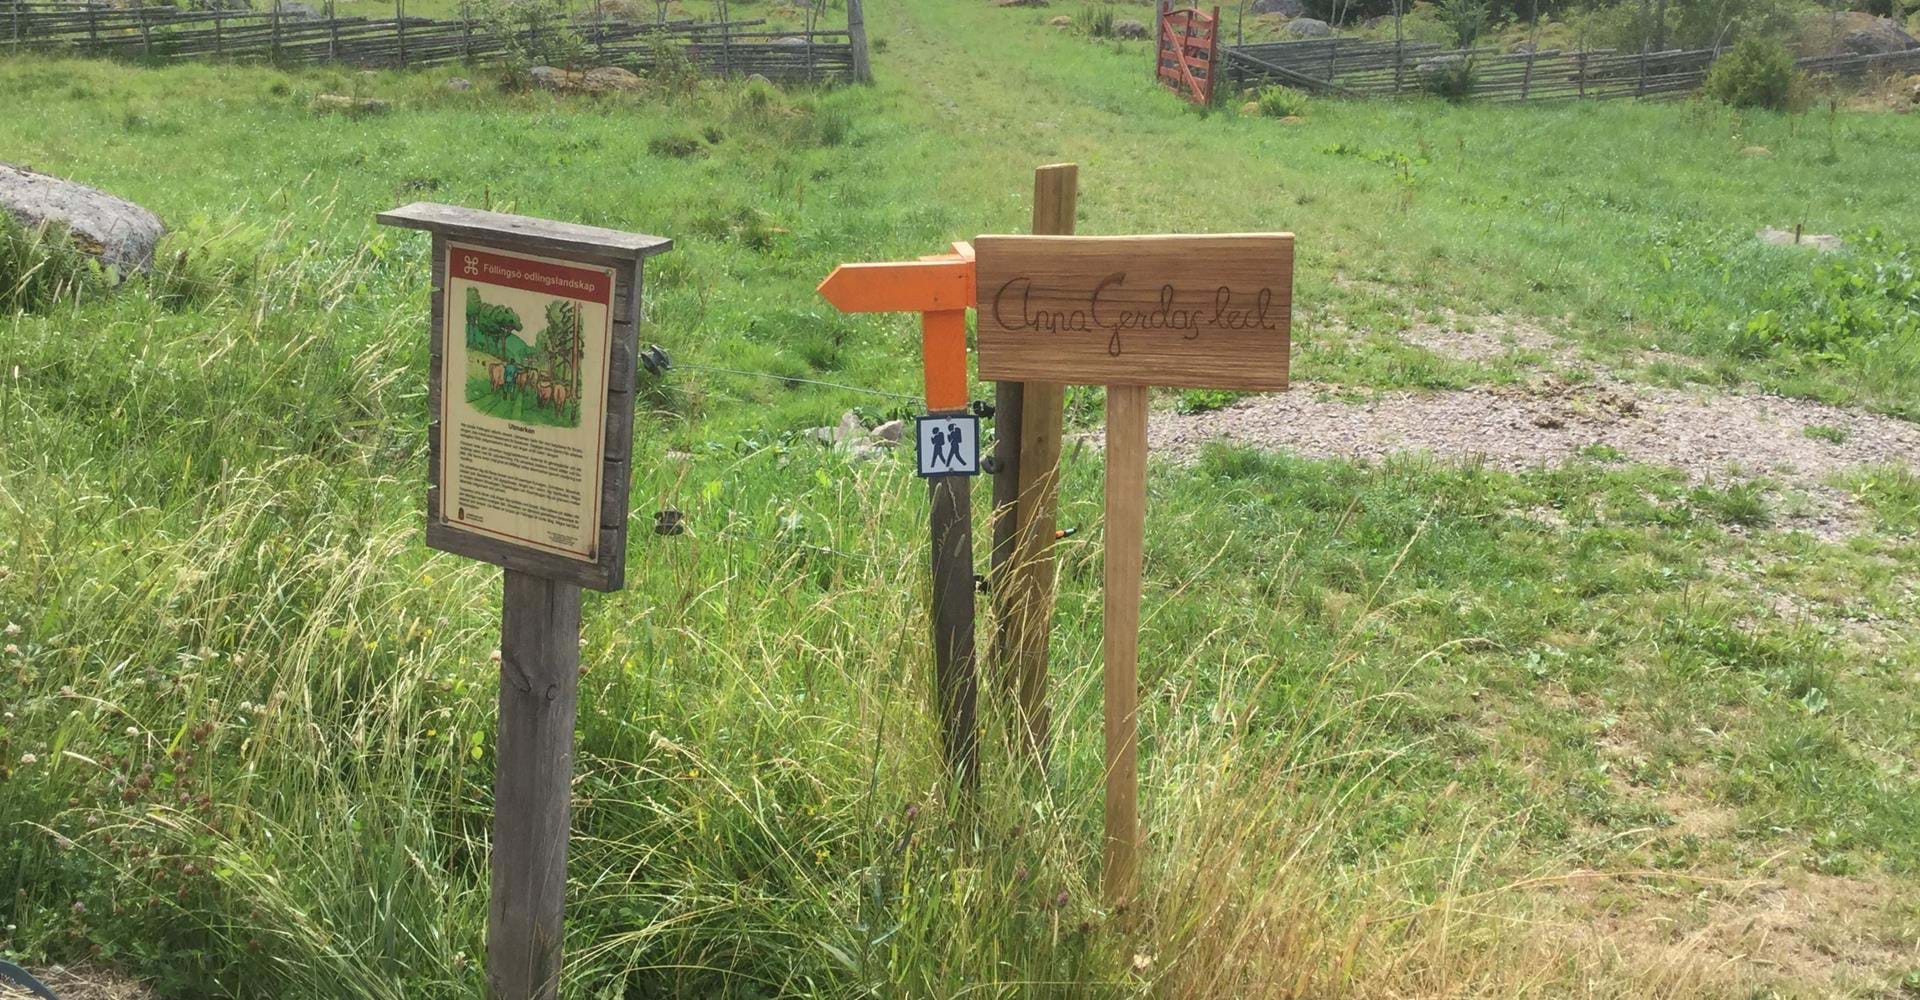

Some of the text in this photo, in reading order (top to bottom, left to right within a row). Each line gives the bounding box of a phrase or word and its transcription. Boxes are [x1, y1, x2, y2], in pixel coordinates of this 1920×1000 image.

[483, 263, 596, 293] Föllingsö odlingslandskap
[992, 272, 1276, 357] Anna Gerdas led
